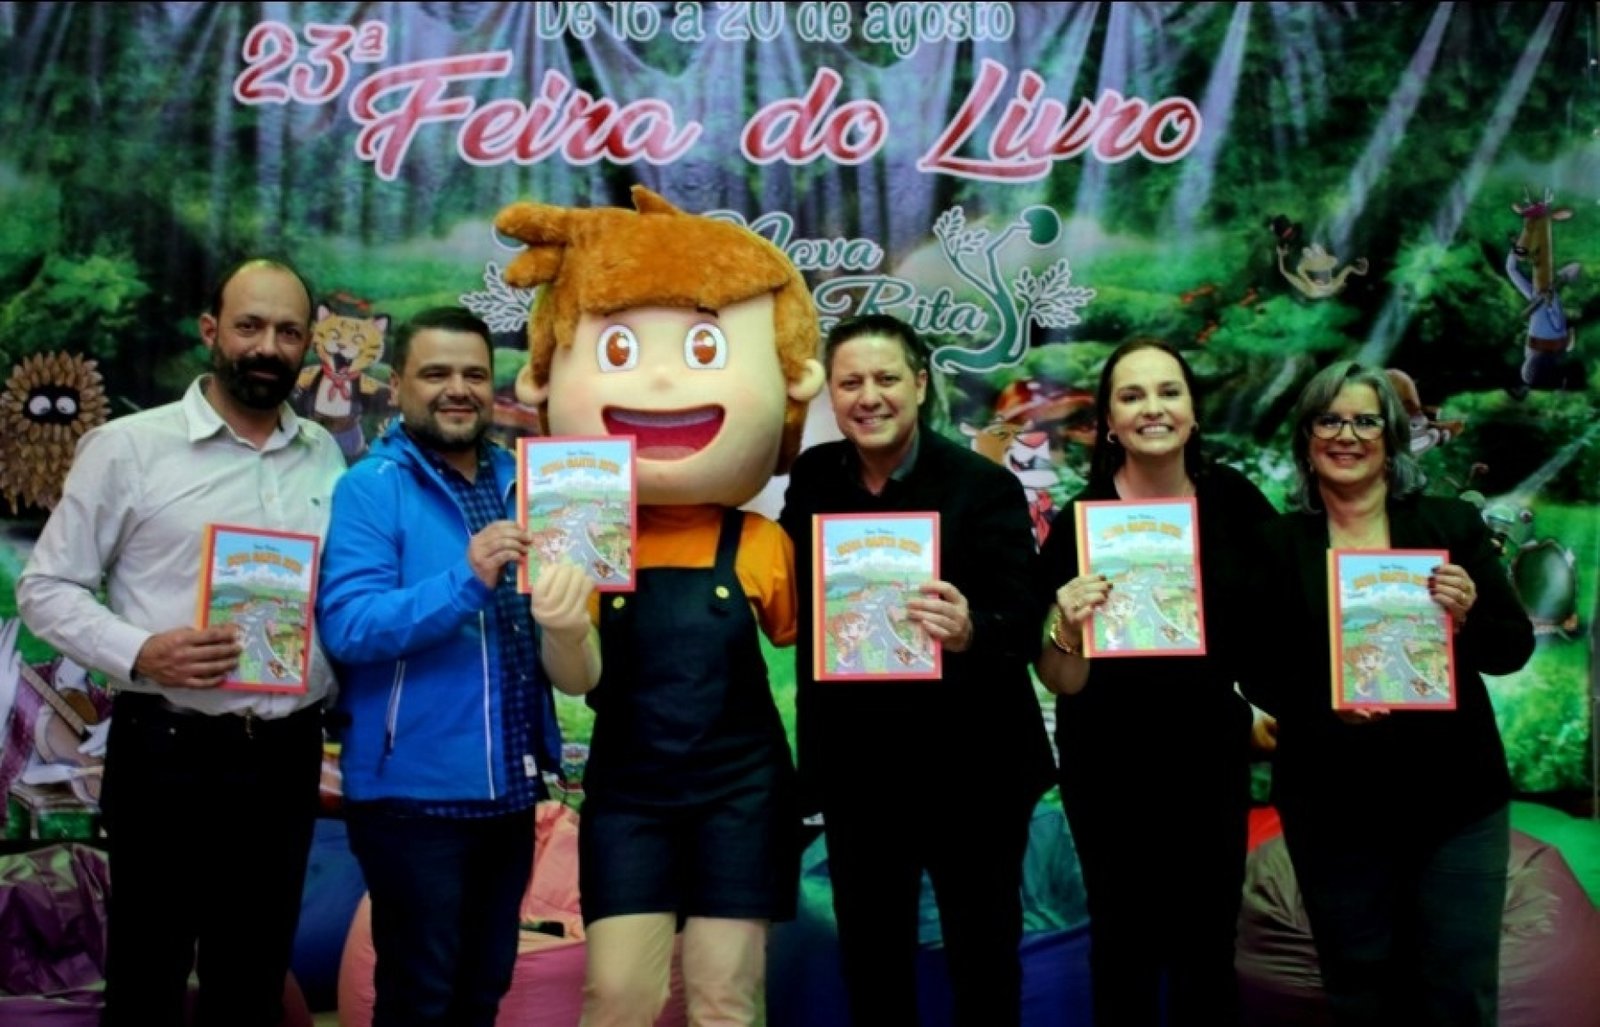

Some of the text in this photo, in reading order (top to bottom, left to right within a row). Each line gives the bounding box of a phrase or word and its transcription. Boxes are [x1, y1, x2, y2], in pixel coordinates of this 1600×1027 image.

[533, 2, 1015, 58] De 16 a 20 de agosto
[235, 20, 1201, 182] 23ª Feira do Livro
[813, 274, 989, 336] Rita
